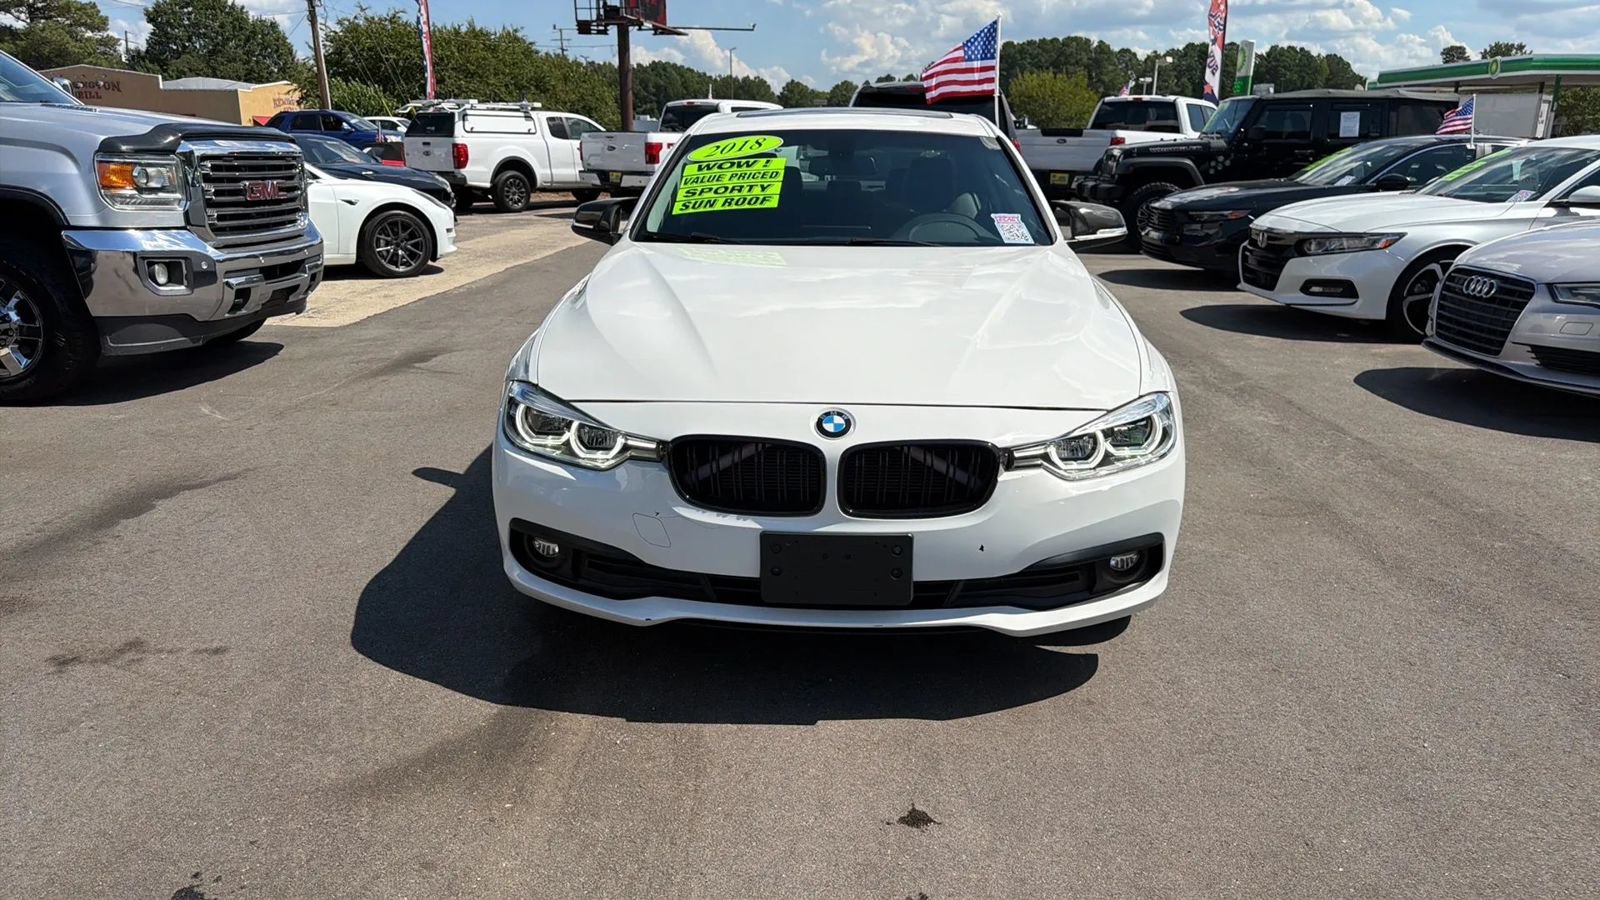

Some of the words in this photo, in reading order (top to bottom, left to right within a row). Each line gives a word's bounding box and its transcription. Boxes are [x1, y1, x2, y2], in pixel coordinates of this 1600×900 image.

[704, 138, 766, 158] 2018
[683, 174, 726, 185] VALUE
[729, 171, 780, 181] PRICED
[683, 184, 772, 198] SPORTY
[680, 199, 718, 211] SUN
[721, 196, 772, 208] ROOF
